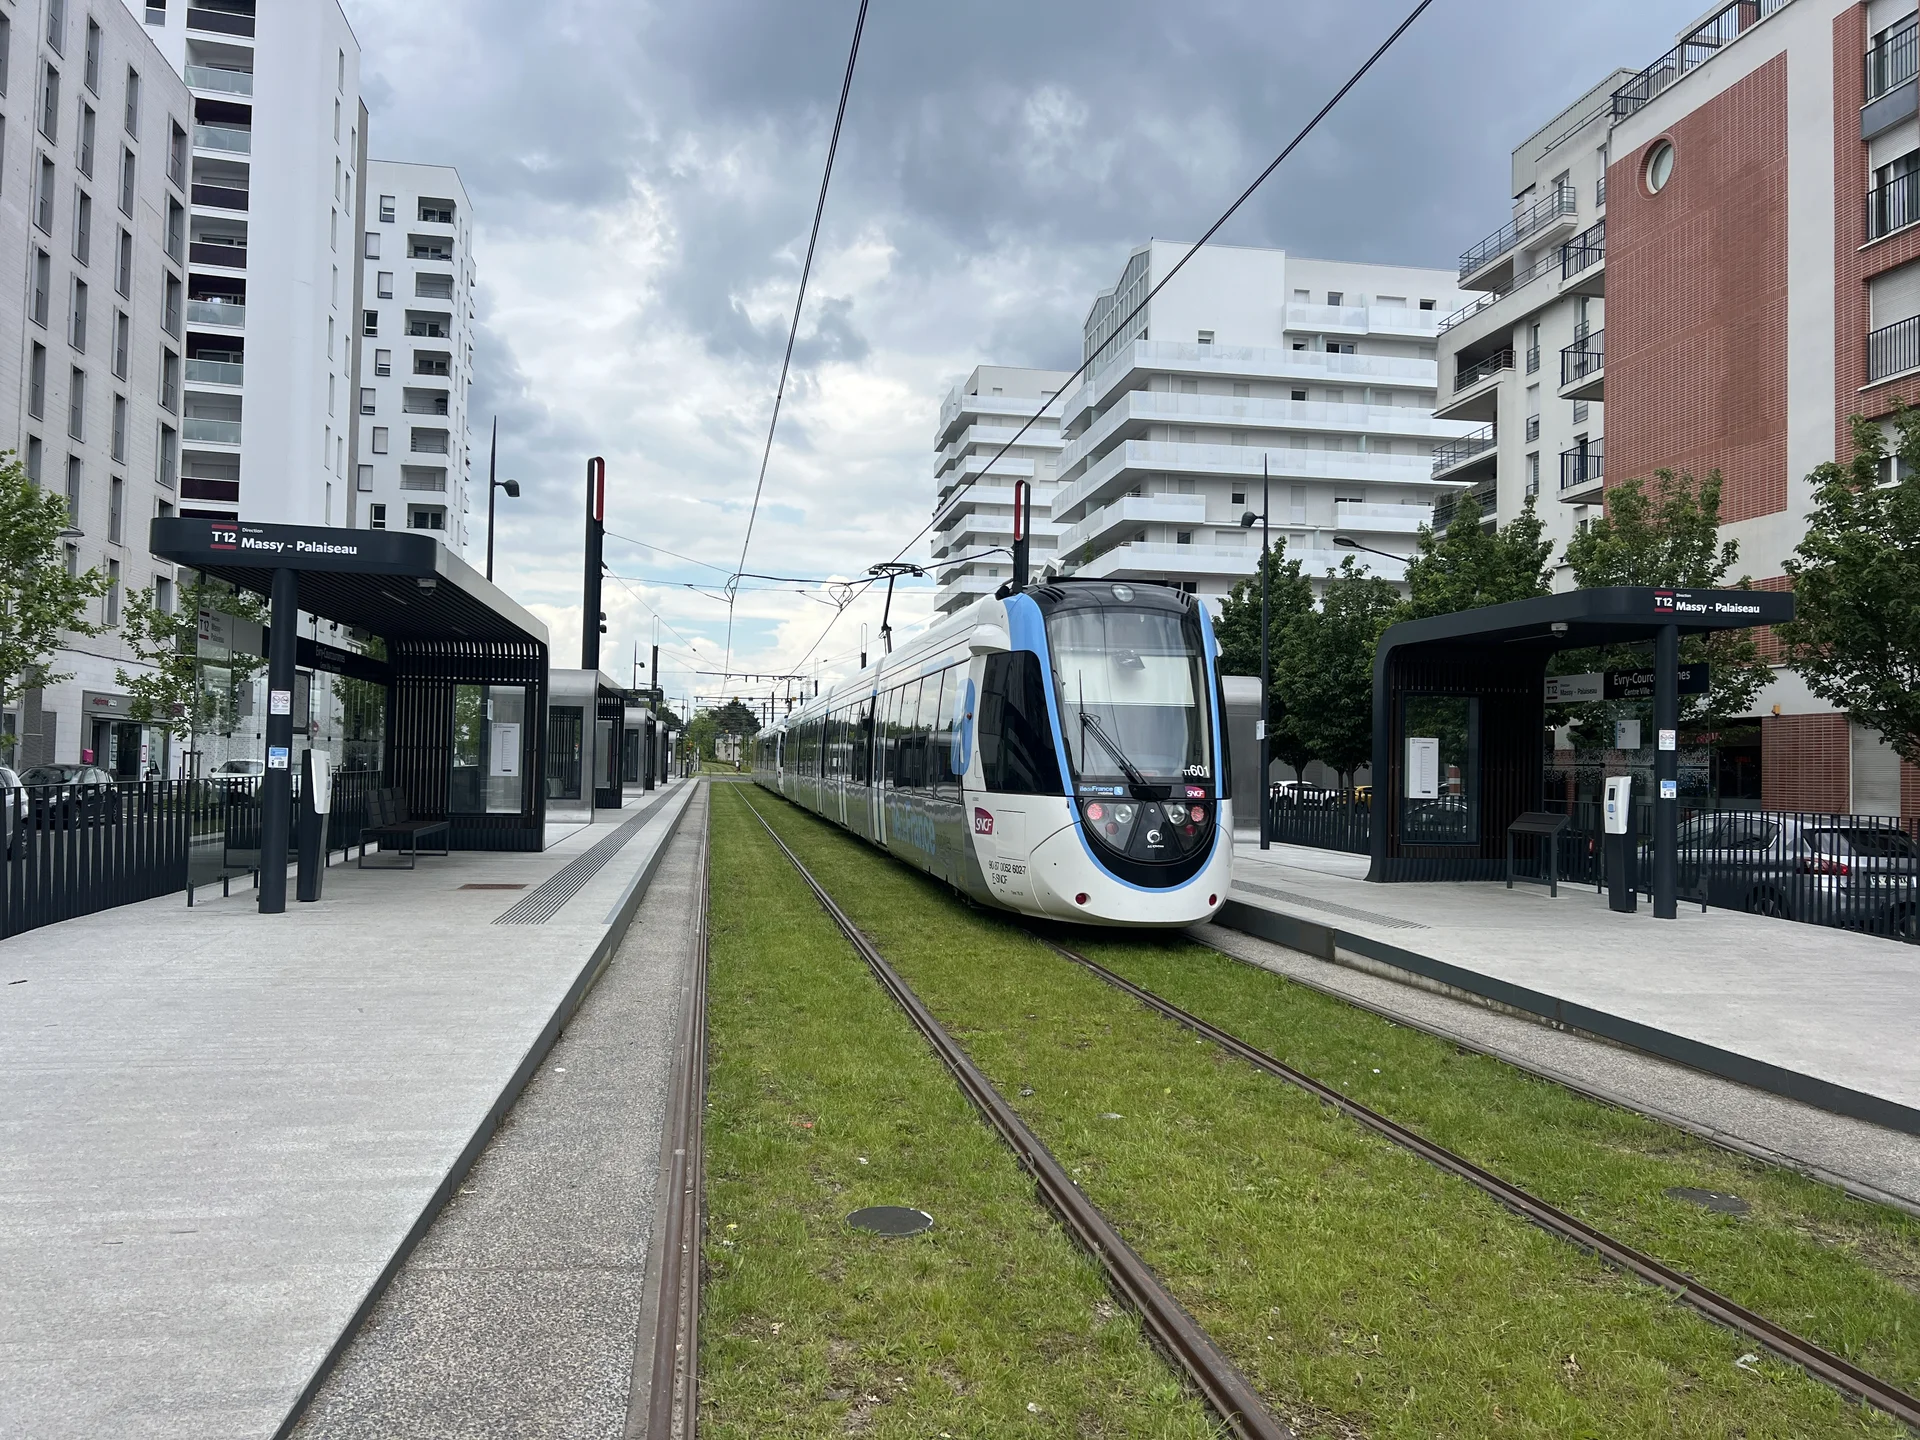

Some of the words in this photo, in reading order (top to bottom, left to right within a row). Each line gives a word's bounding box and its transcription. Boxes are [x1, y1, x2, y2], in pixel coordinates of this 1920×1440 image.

[211, 531, 237, 543] T12
[241, 537, 285, 553] Massy
[296, 541, 358, 555] Palaiseau
[1654, 597, 1673, 607] T12
[1675, 601, 1708, 614] Massy
[1715, 602, 1760, 613] Palaiseau
[1546, 686, 1558, 695] T12
[1560, 689, 1574, 697] Massy
[1577, 687, 1598, 695] Palaiseau
[1624, 688, 1640, 697] Centre
[1640, 687, 1651, 696] Ville
[1186, 789, 1205, 798] SNCF
[975, 818, 993, 832] SNCF
